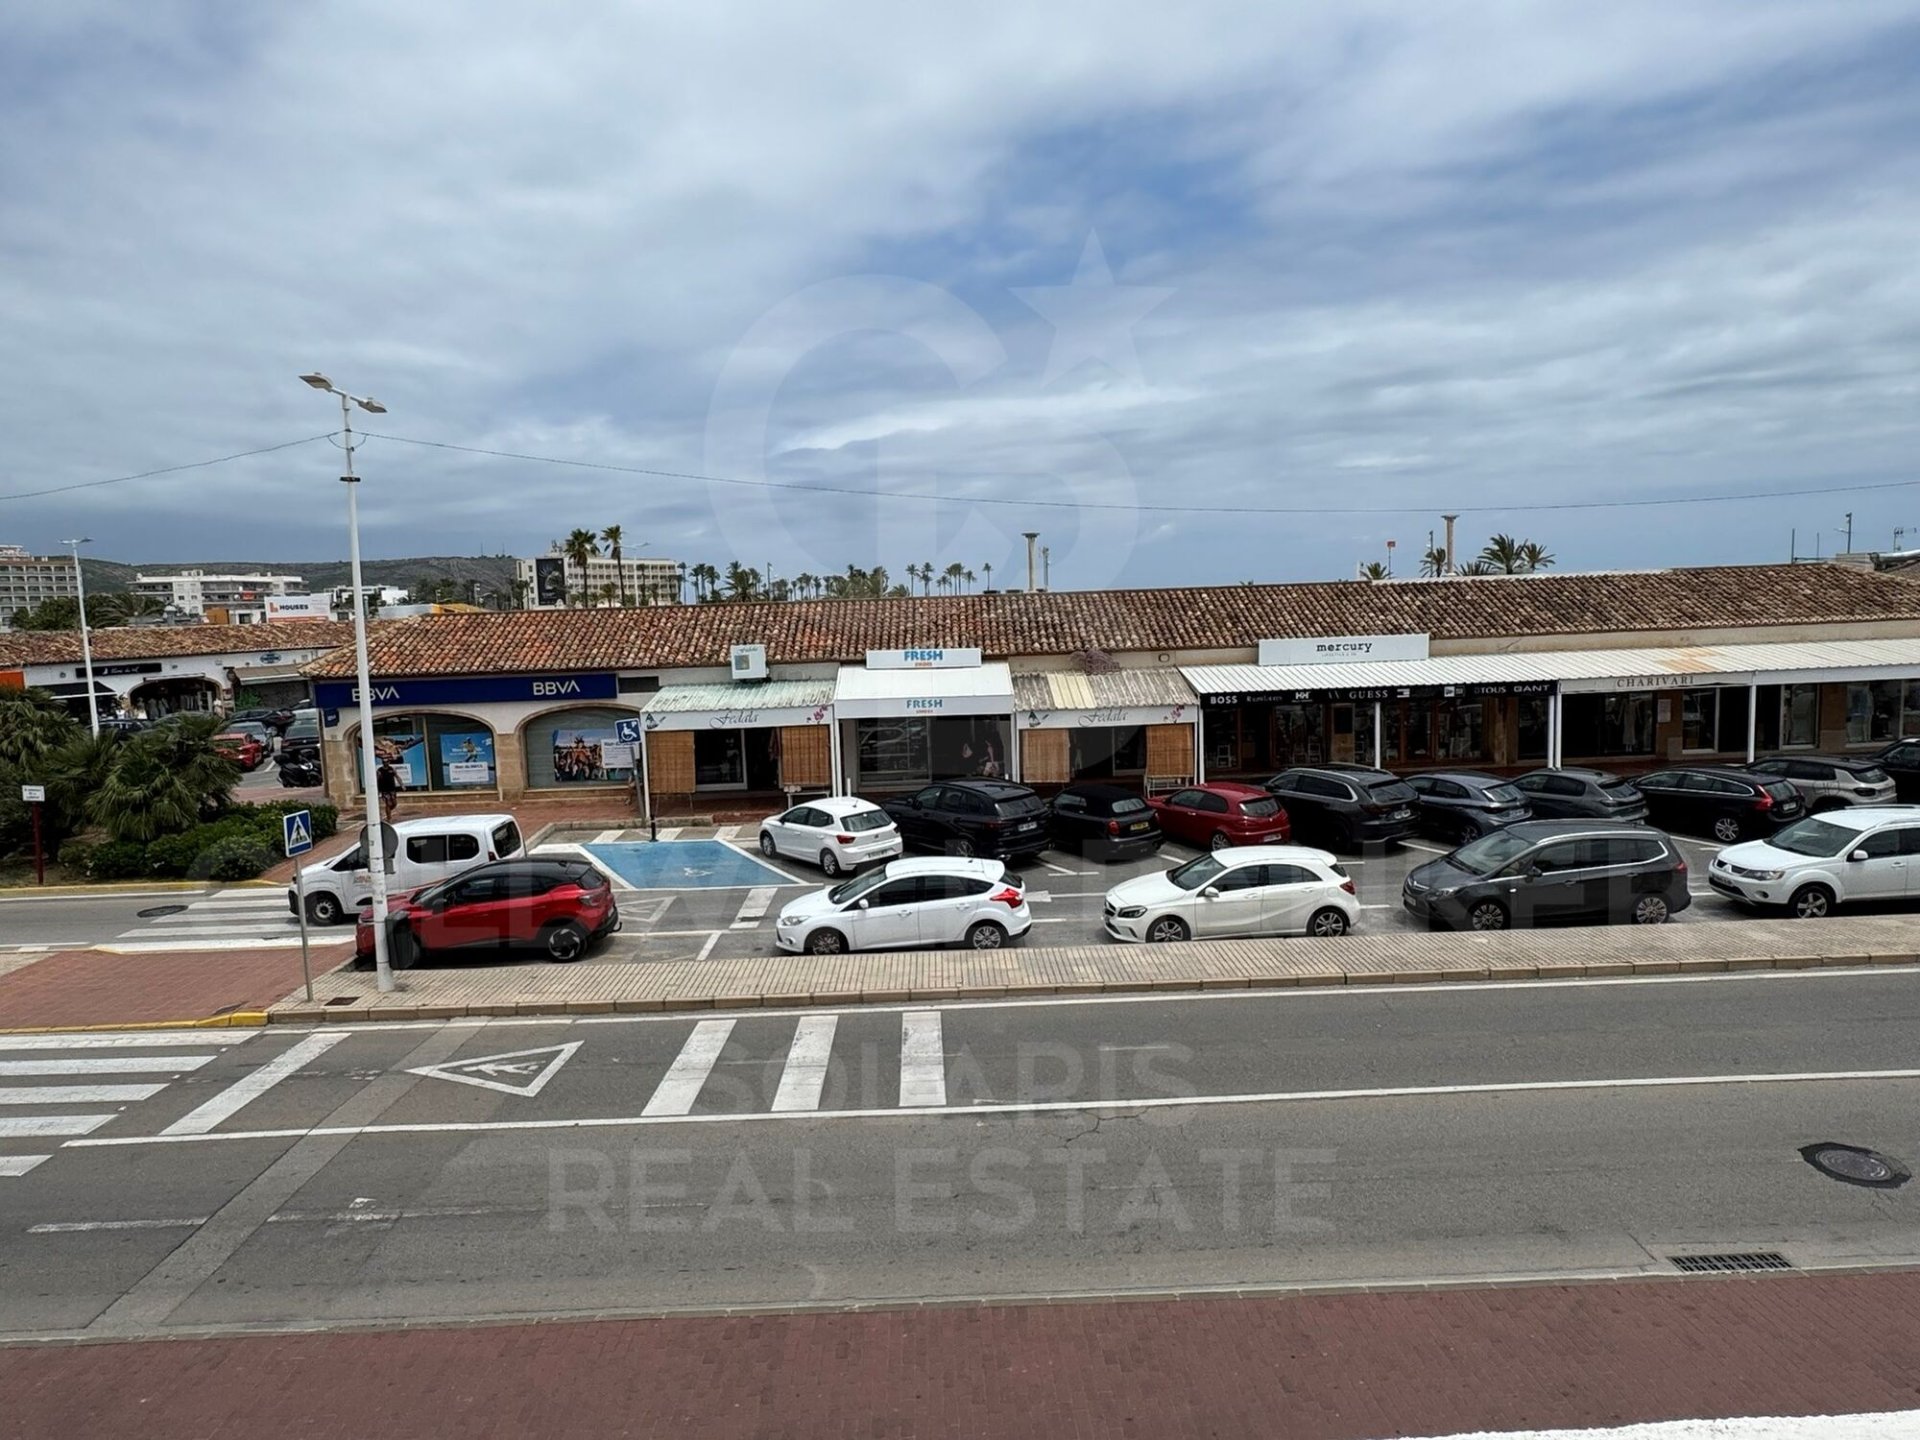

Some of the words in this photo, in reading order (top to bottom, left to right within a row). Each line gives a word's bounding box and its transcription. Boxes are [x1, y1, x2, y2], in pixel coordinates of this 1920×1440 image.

[279, 603, 309, 611] HOUSES
[1316, 642, 1372, 653] mercury
[904, 650, 943, 661] FRESH
[1616, 675, 1694, 688] CHARIVARI
[533, 680, 581, 696] BBVA
[1210, 695, 1238, 704] BOSS
[1348, 689, 1388, 699] GUESS
[1513, 684, 1550, 693] GANT
[906, 699, 943, 709] FRESH
